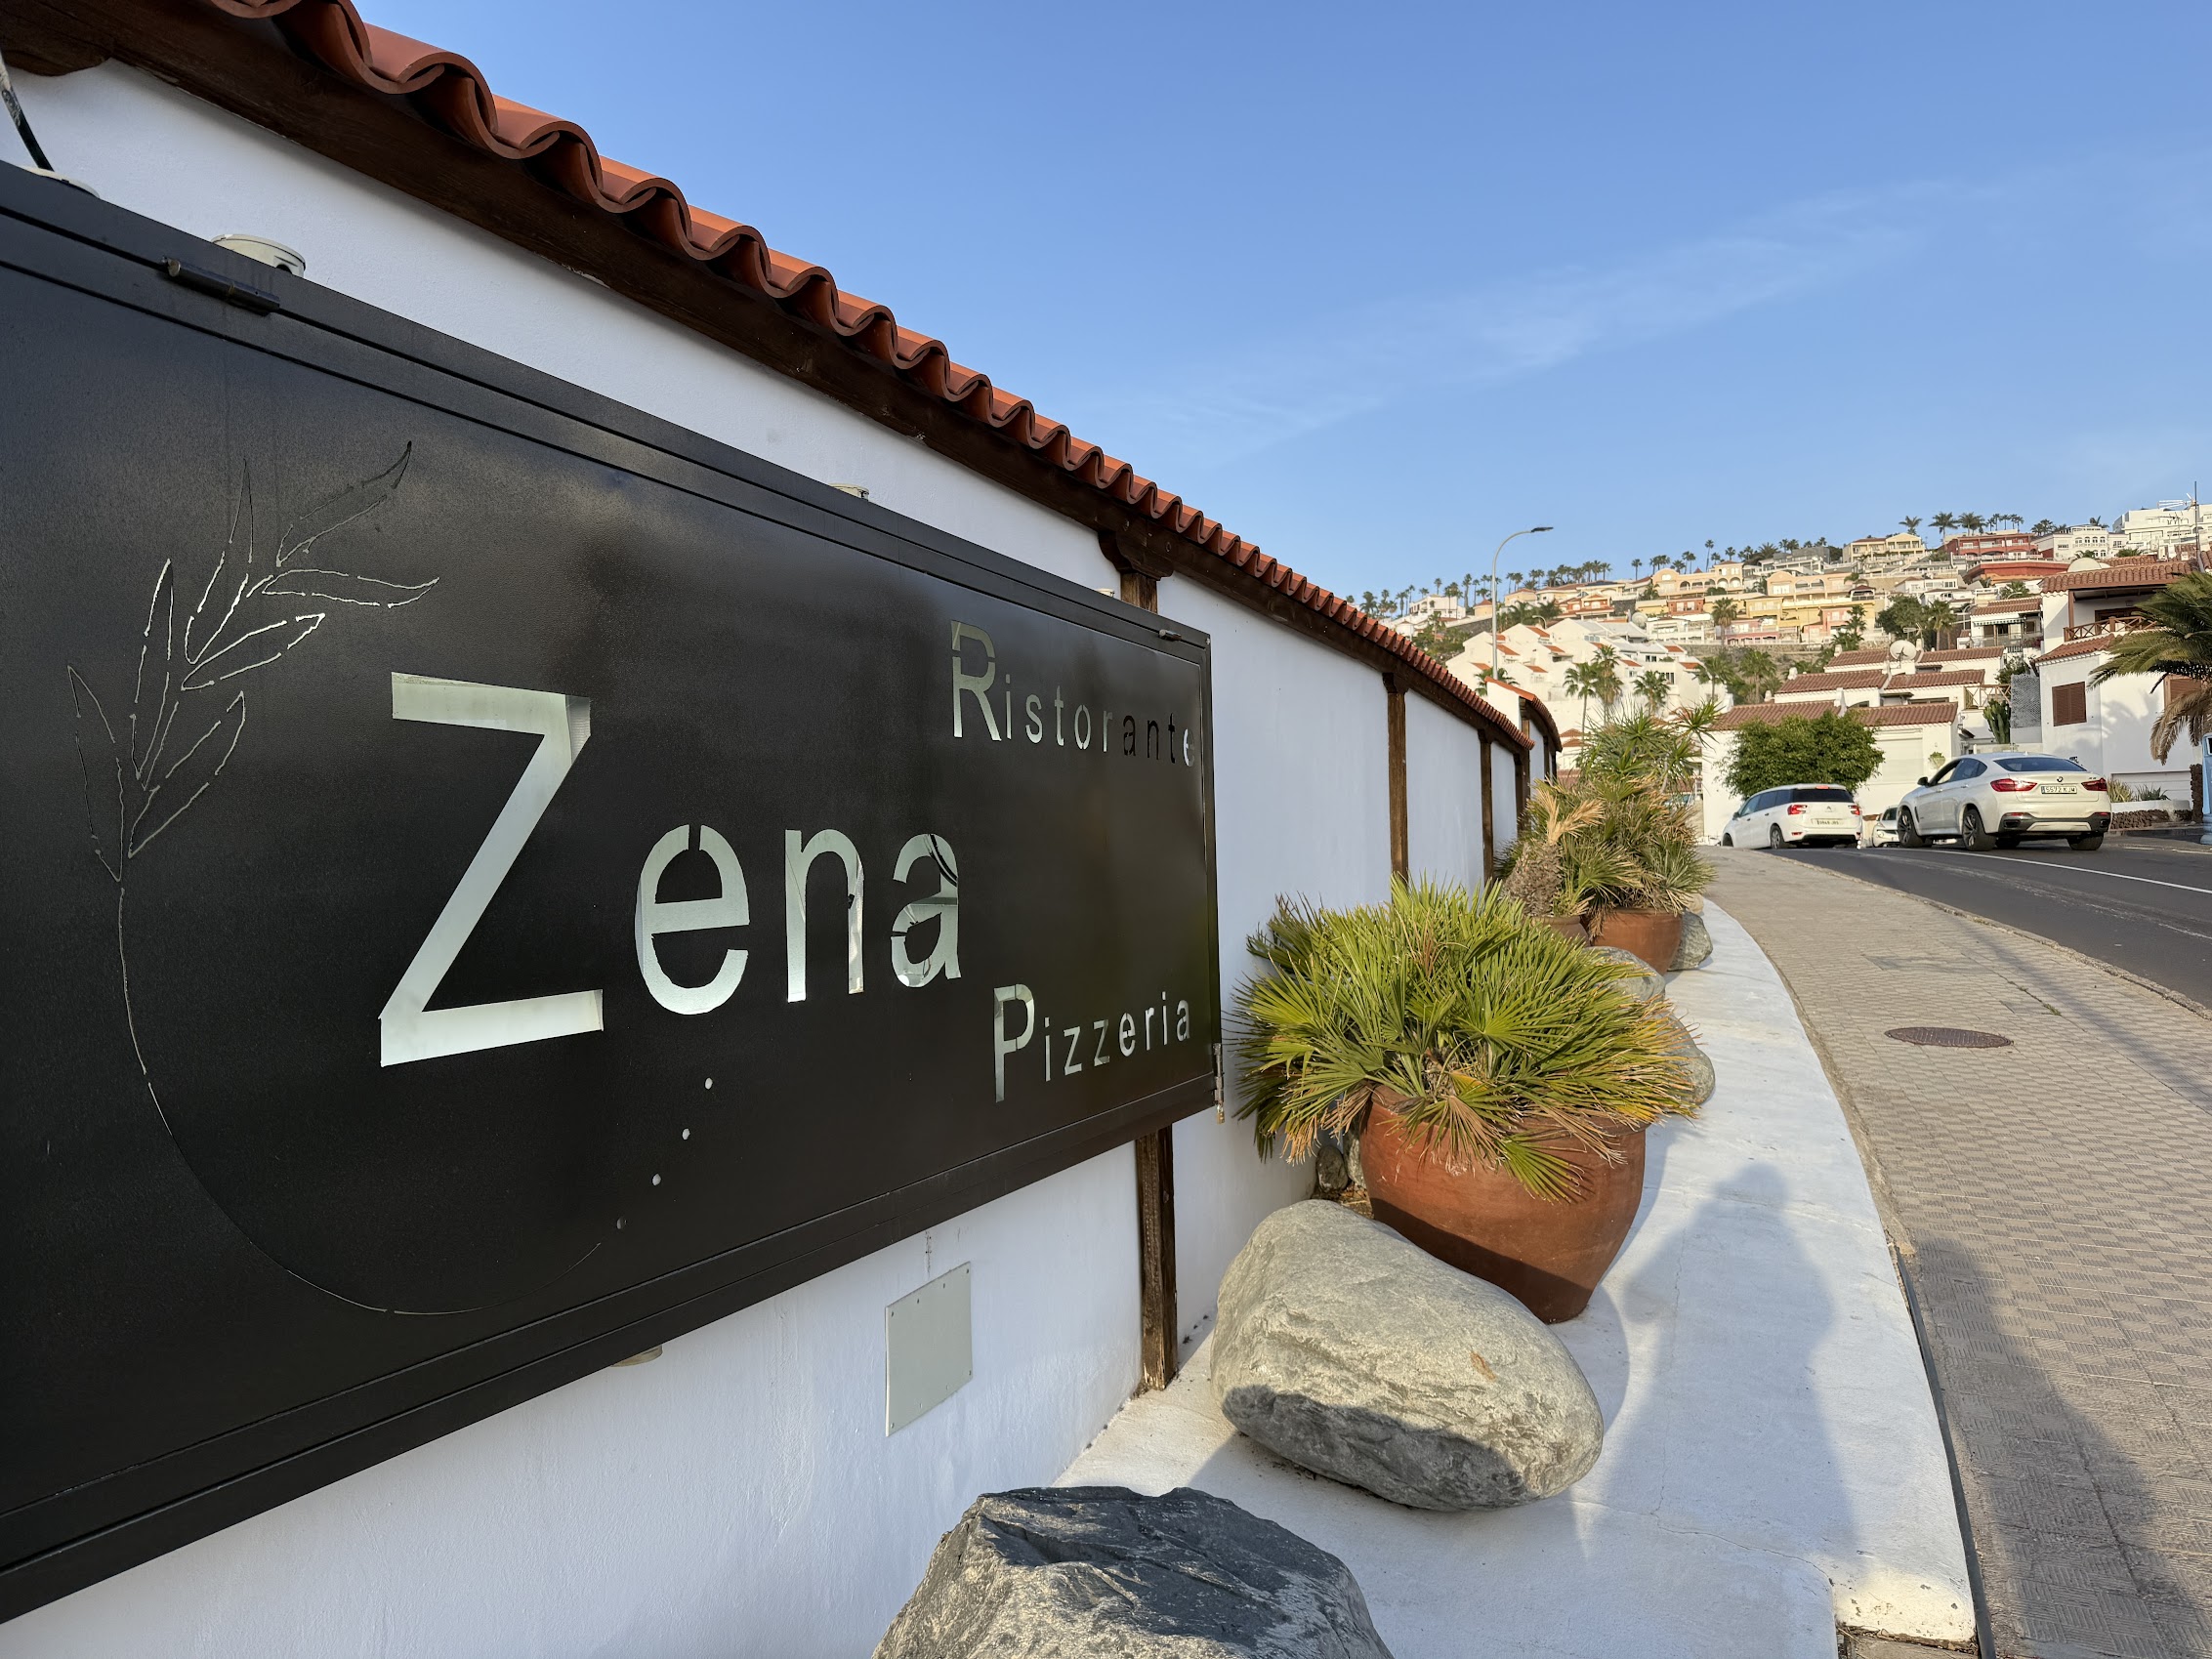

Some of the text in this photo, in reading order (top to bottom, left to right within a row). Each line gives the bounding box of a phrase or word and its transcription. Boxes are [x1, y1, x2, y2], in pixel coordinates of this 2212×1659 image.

[951, 620, 1195, 767] Ristorante
[379, 672, 962, 1067] Zena
[993, 983, 1190, 1103] Pizzeria
